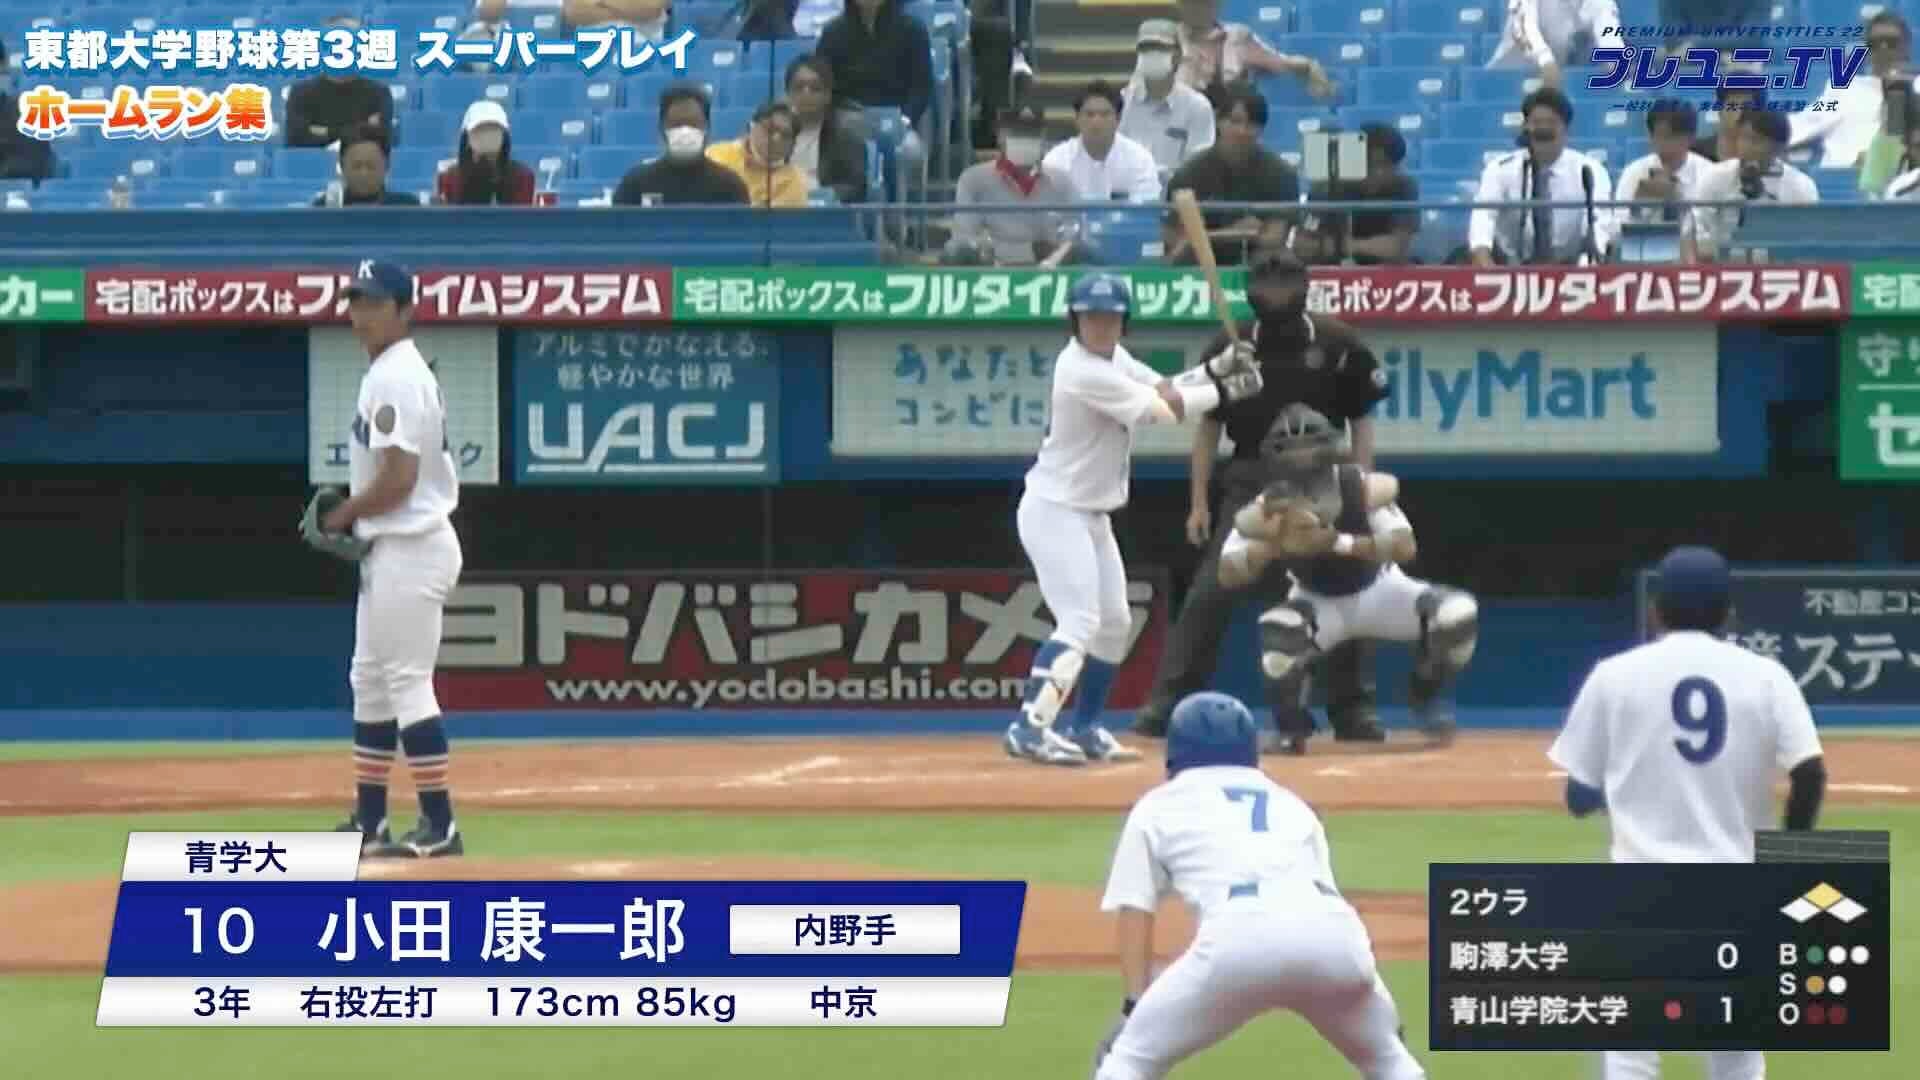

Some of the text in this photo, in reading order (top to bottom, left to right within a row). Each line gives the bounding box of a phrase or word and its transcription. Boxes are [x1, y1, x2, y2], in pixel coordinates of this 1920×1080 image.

[357, 259, 376, 279] K
[527, 401, 766, 472] UACJ
[440, 580, 1153, 665] ヨドバシカメ
[1671, 676, 1726, 764] 9
[1222, 786, 1268, 833] 7
